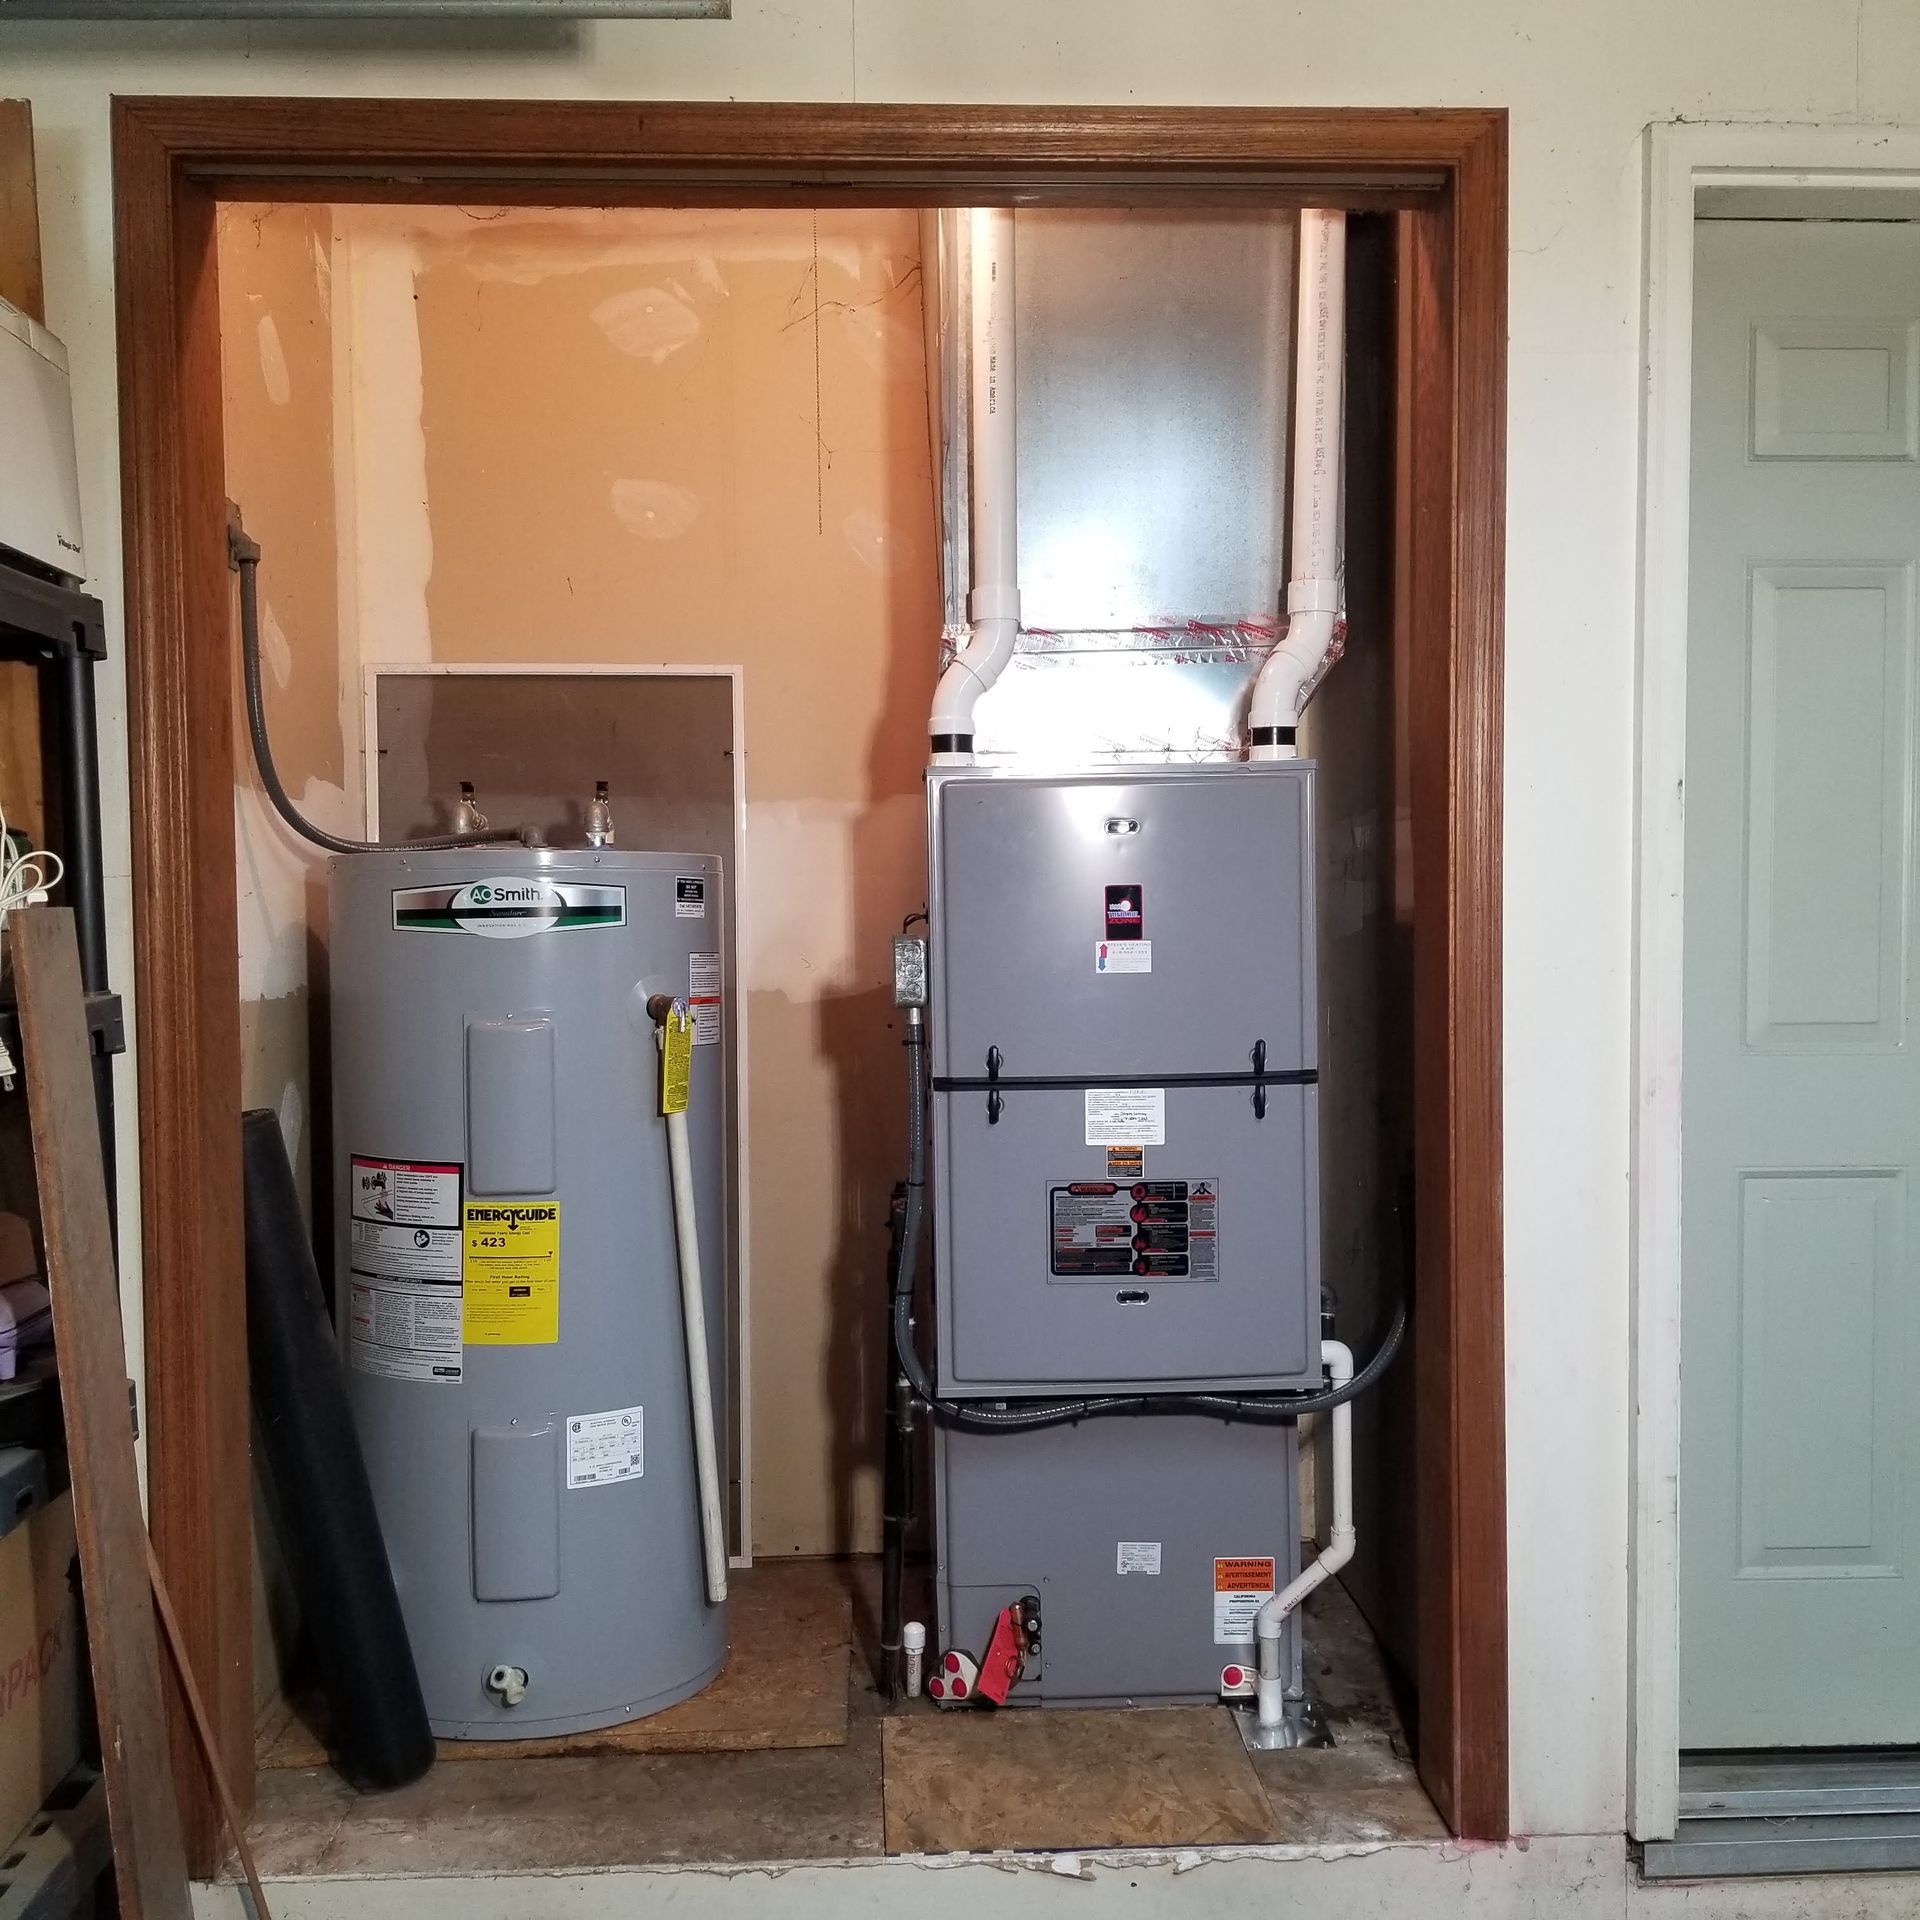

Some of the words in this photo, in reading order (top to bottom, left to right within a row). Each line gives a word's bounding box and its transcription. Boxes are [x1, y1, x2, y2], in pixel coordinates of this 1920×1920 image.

[494, 887, 541, 901] Smith
[466, 1208, 557, 1225] ENERGYGUIDE
[480, 1237, 506, 1248] 423
